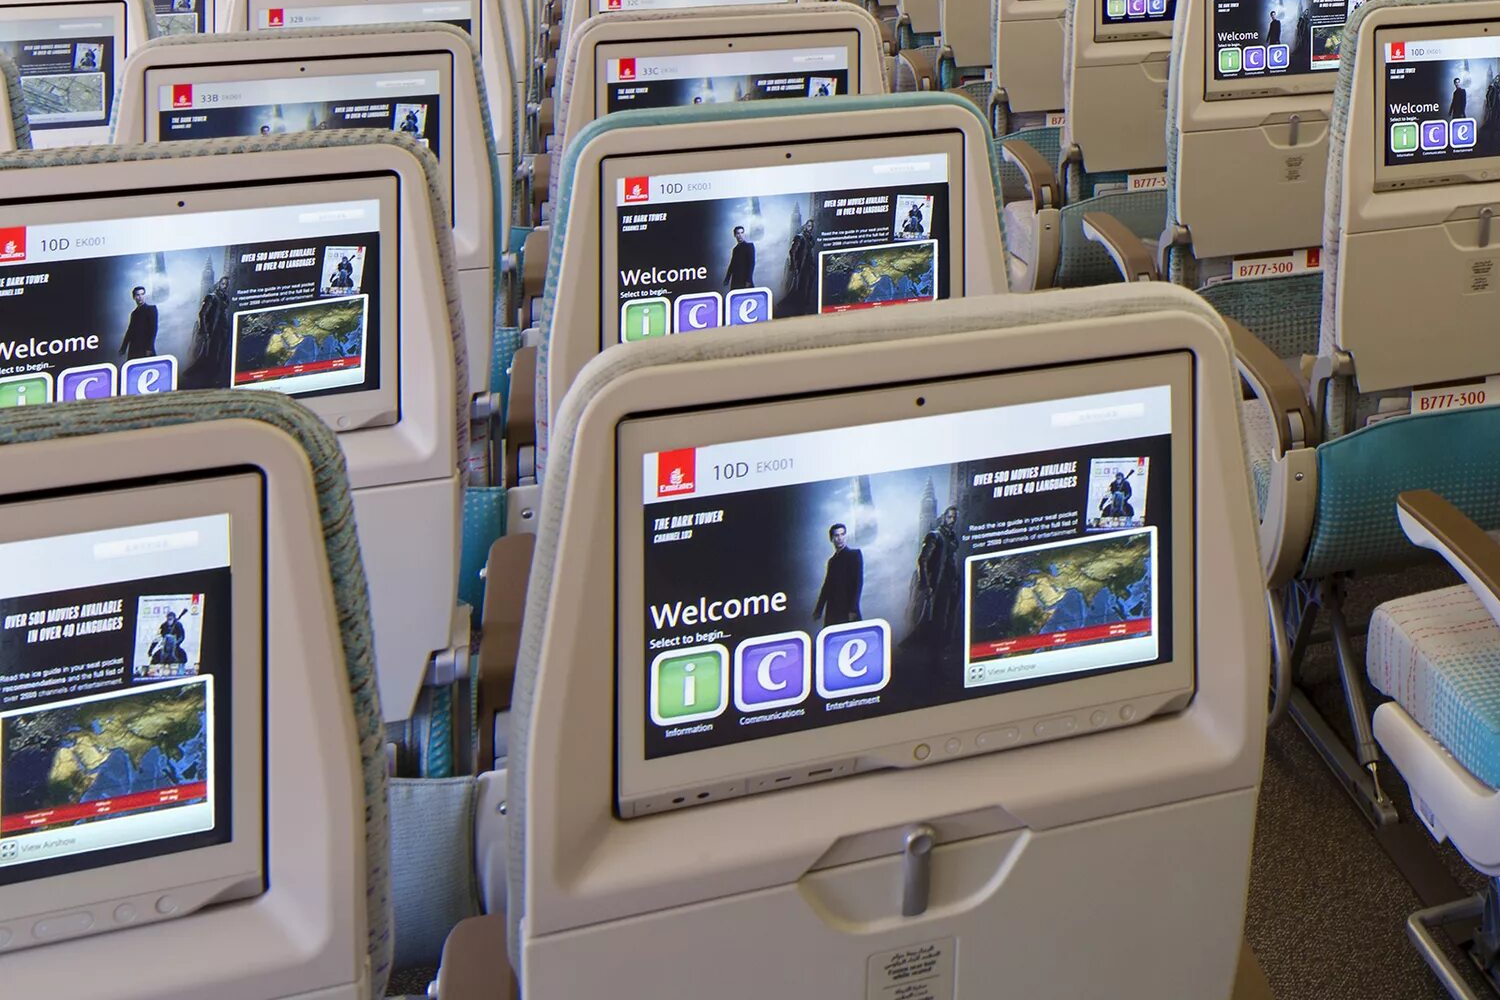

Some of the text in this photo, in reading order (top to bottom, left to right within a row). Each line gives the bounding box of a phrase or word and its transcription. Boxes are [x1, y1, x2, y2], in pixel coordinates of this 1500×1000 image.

[1218, 32, 1258, 41] Welcome
[1390, 103, 1439, 114] Welcome
[661, 183, 711, 194] 10D EK001
[1134, 176, 1166, 188] B777-3
[41, 237, 105, 251] 10D EK001
[621, 267, 707, 286] Welcome
[1240, 262, 1294, 277] B777-300
[6, 274, 49, 287] DARK TOWER
[643, 308, 649, 335] i
[740, 299, 758, 323] e
[0, 335, 99, 361] Welcome
[138, 369, 159, 396] e
[1420, 390, 1486, 411] B777-300
[714, 458, 793, 480] 10D EK001
[973, 461, 1076, 486] OVER 500 MOVIES AVAILABLE
[660, 482, 693, 492] Emirates
[993, 476, 1077, 498] IN OVER 40 LANGUAGES
[654, 510, 723, 530] THE DARK TOWER
[654, 531, 681, 543] CHANNEL
[971, 527, 1027, 539] recommendations
[5, 599, 123, 629] OVER 500 MOVIES AVAILABLE
[650, 592, 786, 629] Welcome
[28, 616, 123, 643] IN OVER 40 LANGUAGES
[650, 636, 680, 649] Select
[682, 635, 693, 644] to
[684, 663, 694, 705] i
[838, 639, 867, 677] e
[1006, 664, 1036, 673] Airshow
[666, 696, 880, 737] Information Communications Entertainment
